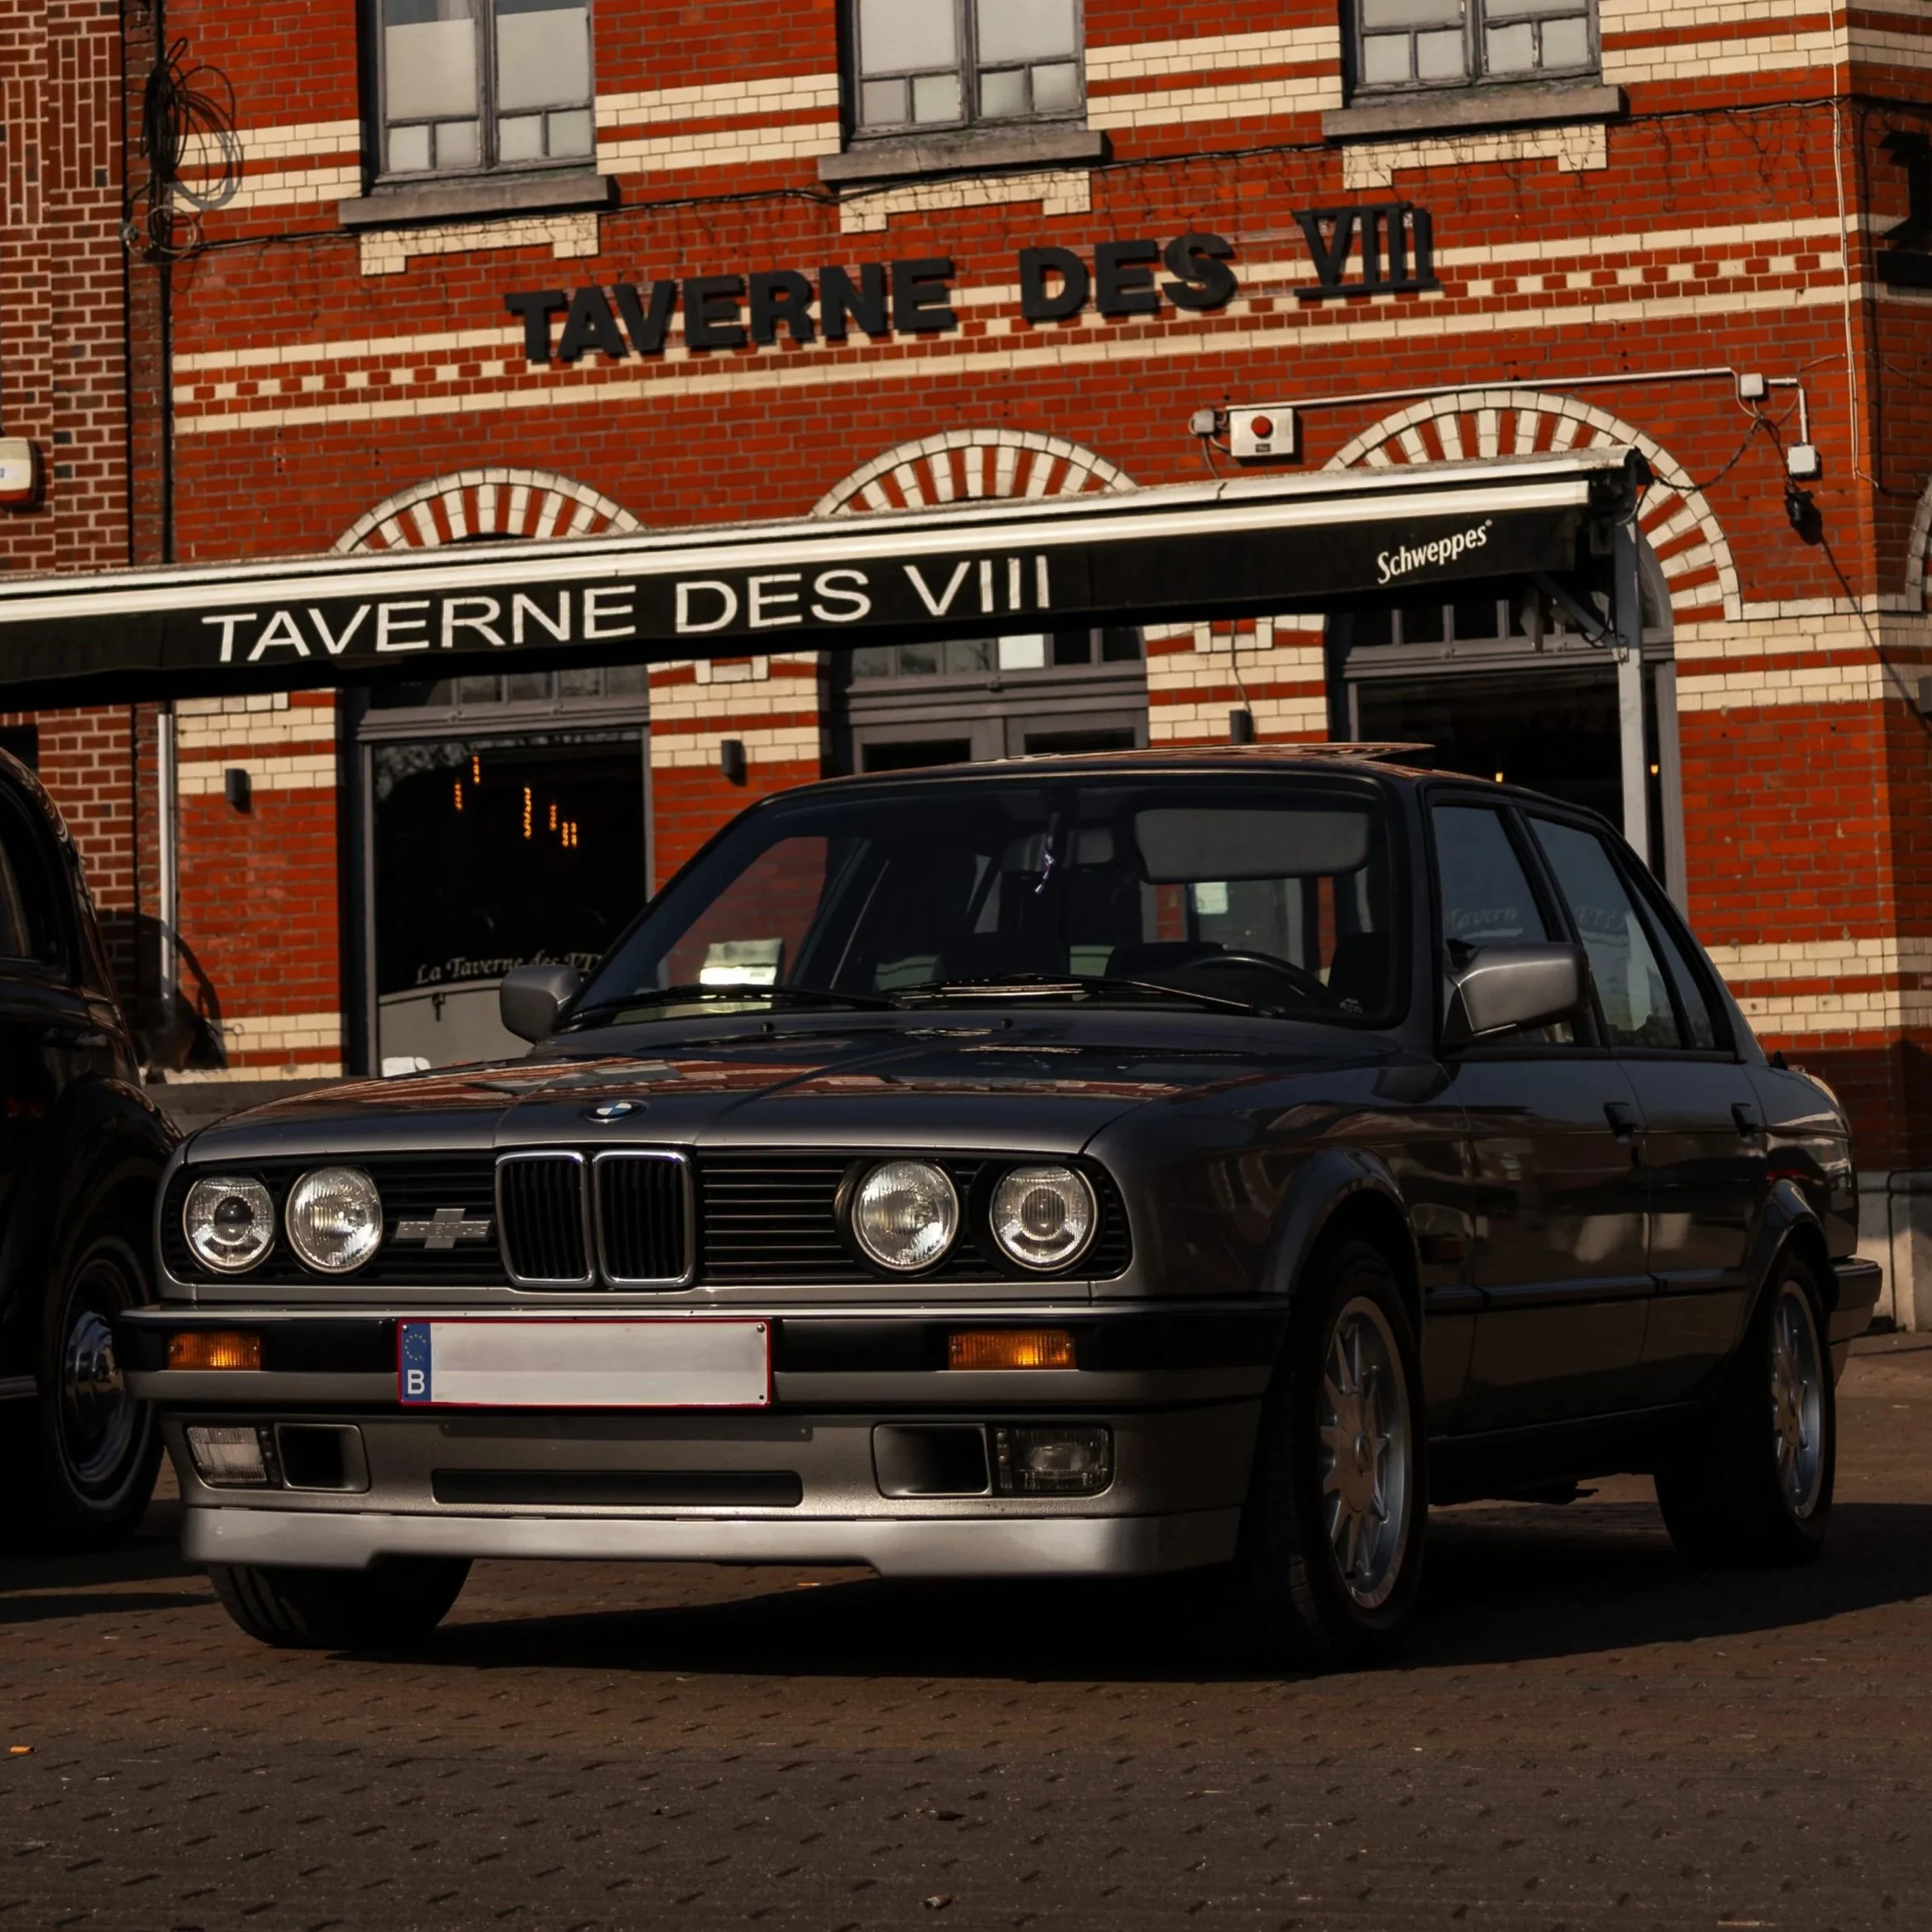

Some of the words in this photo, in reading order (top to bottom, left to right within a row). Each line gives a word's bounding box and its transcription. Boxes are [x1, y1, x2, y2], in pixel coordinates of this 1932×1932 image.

[505, 257, 954, 364] TAVERNE
[1019, 232, 1234, 320] DES
[1291, 203, 1439, 298] VIII
[1376, 524, 1487, 584] Schweppes
[201, 584, 637, 663] TAVERNE
[674, 569, 872, 634] DES
[903, 555, 1051, 617] VIII
[413, 963, 442, 985] La
[446, 955, 525, 979] Taverne
[408, 1369, 426, 1395] B
